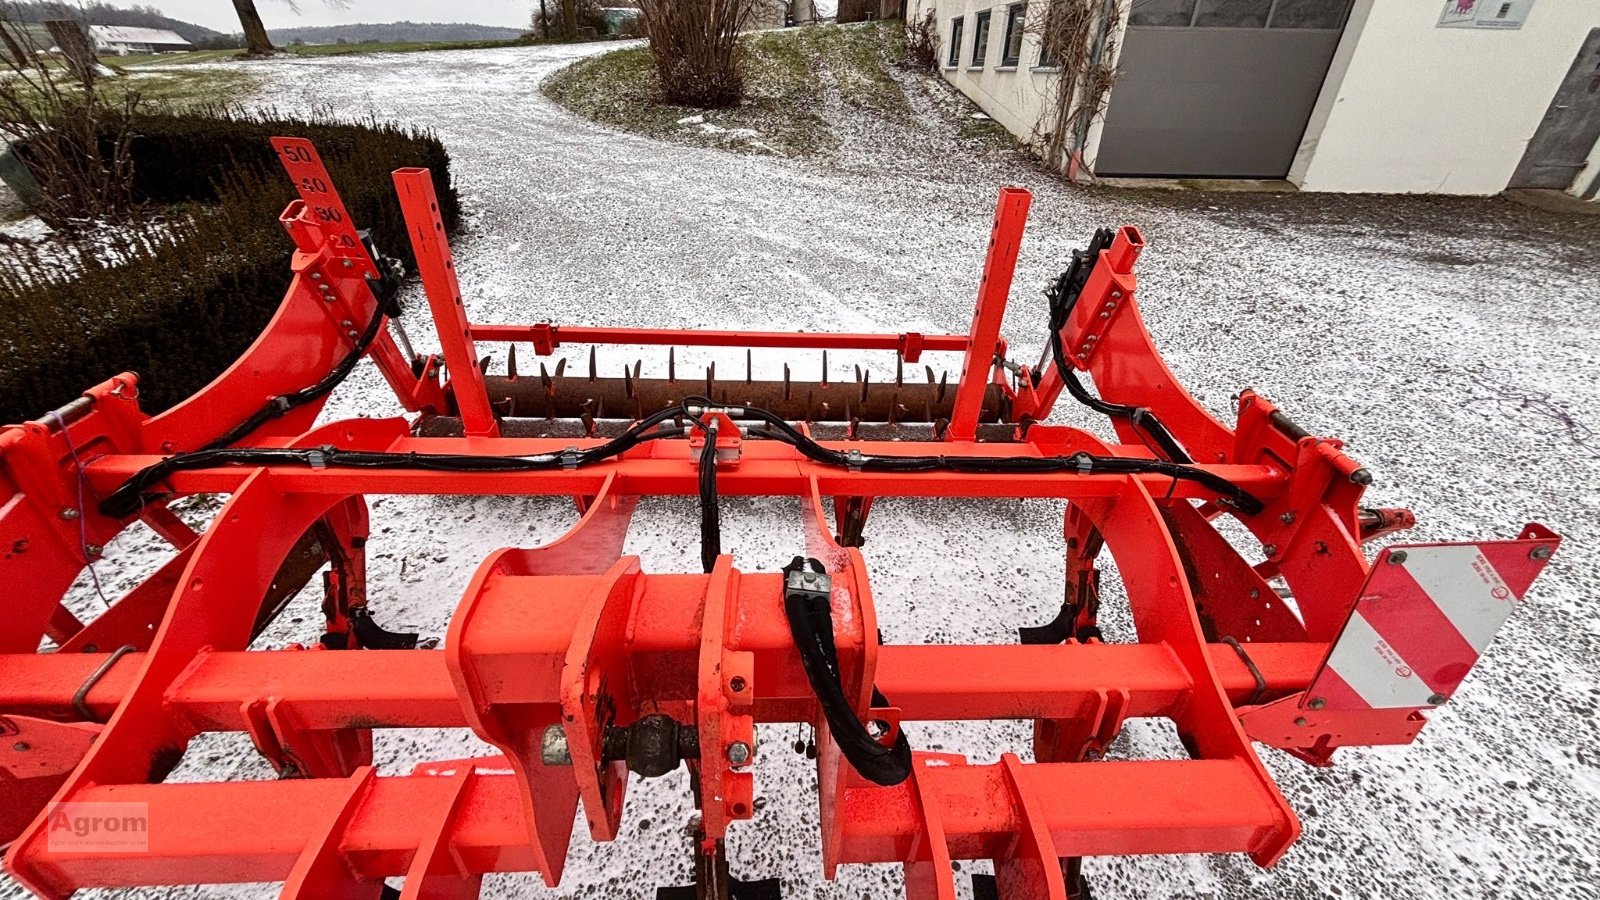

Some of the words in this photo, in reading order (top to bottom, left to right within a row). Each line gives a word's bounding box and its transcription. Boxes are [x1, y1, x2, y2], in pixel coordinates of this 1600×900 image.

[284, 146, 311, 162] 50
[302, 178, 327, 193] 40
[316, 206, 341, 222] 30
[330, 234, 355, 248] 20
